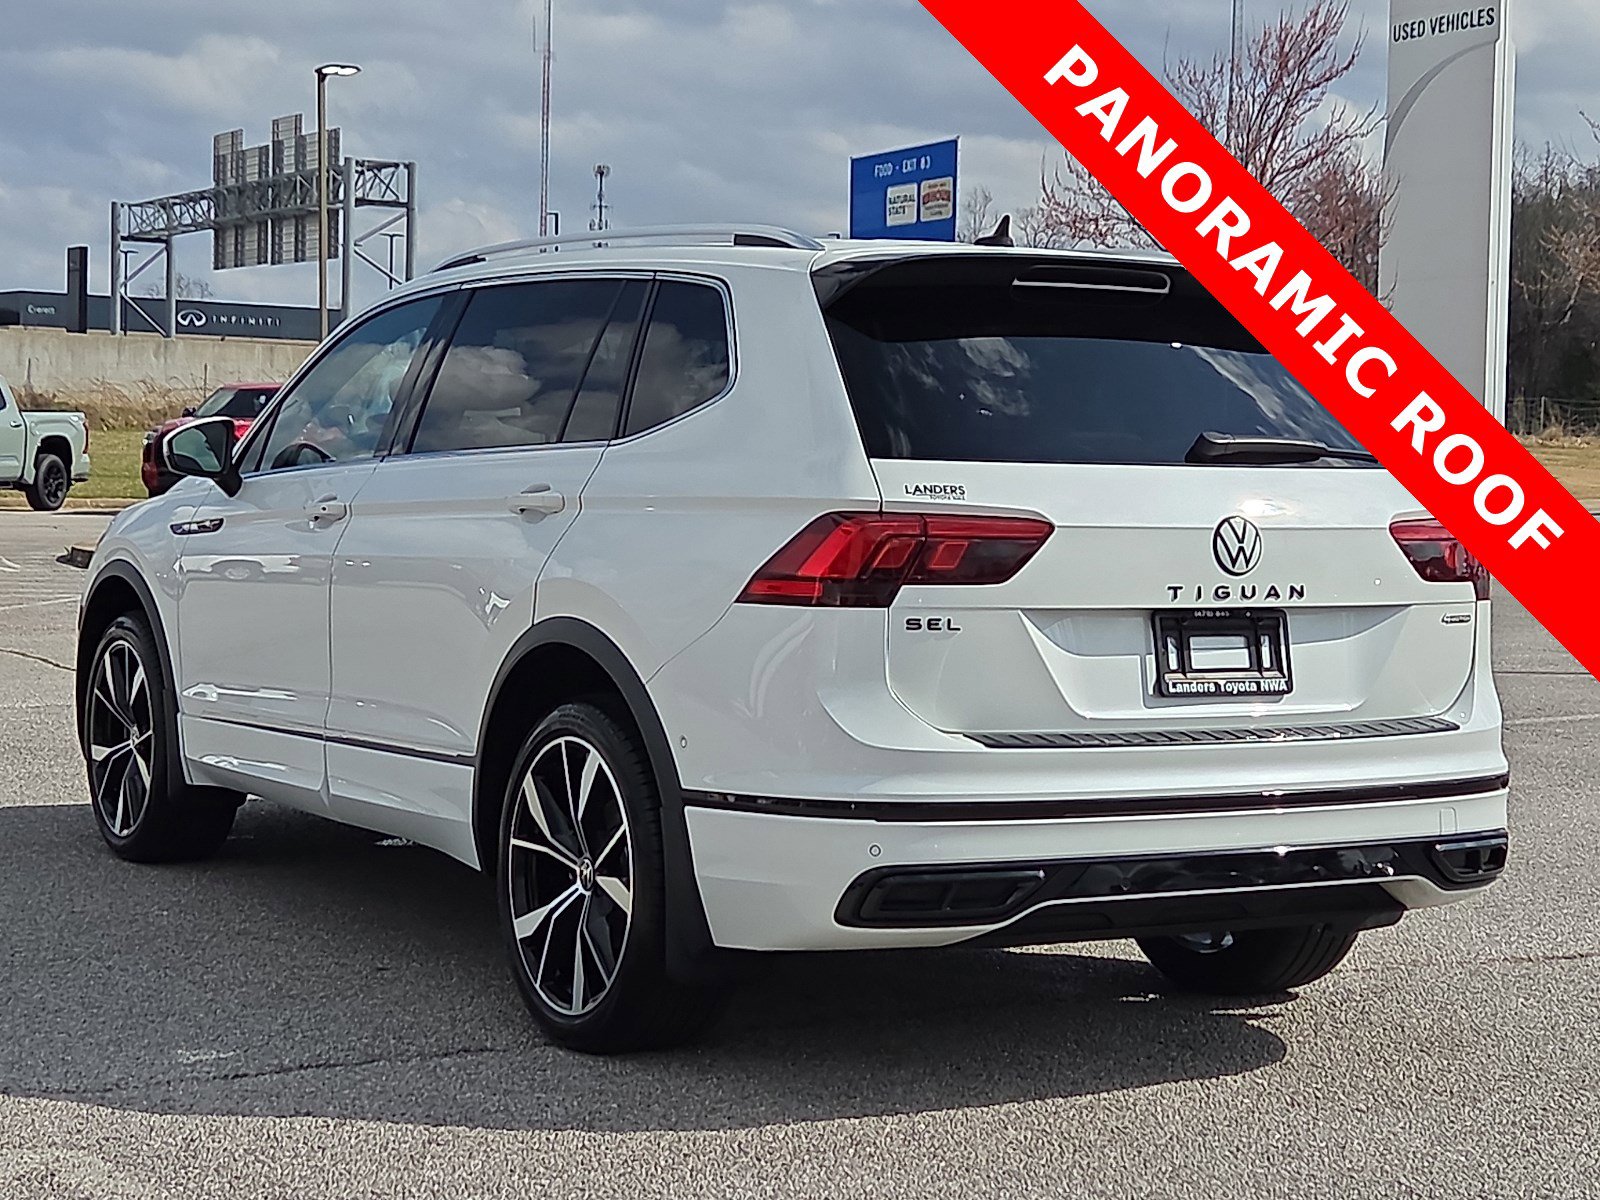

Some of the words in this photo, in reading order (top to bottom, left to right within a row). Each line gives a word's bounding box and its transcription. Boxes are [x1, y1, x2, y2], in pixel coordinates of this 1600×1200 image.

[1393, 20, 1426, 42] USED
[1429, 7, 1495, 35] VEHICLES
[874, 162, 893, 178] FOOD
[902, 158, 917, 173] EXIT
[212, 315, 280, 327] INFINITI
[904, 484, 966, 496] LANDERS
[1166, 584, 1305, 602] TIGUAN
[905, 617, 962, 631] SEL
[1168, 680, 1215, 693] Landers
[1220, 680, 1258, 694] Toyota
[1260, 679, 1288, 692] NWA
